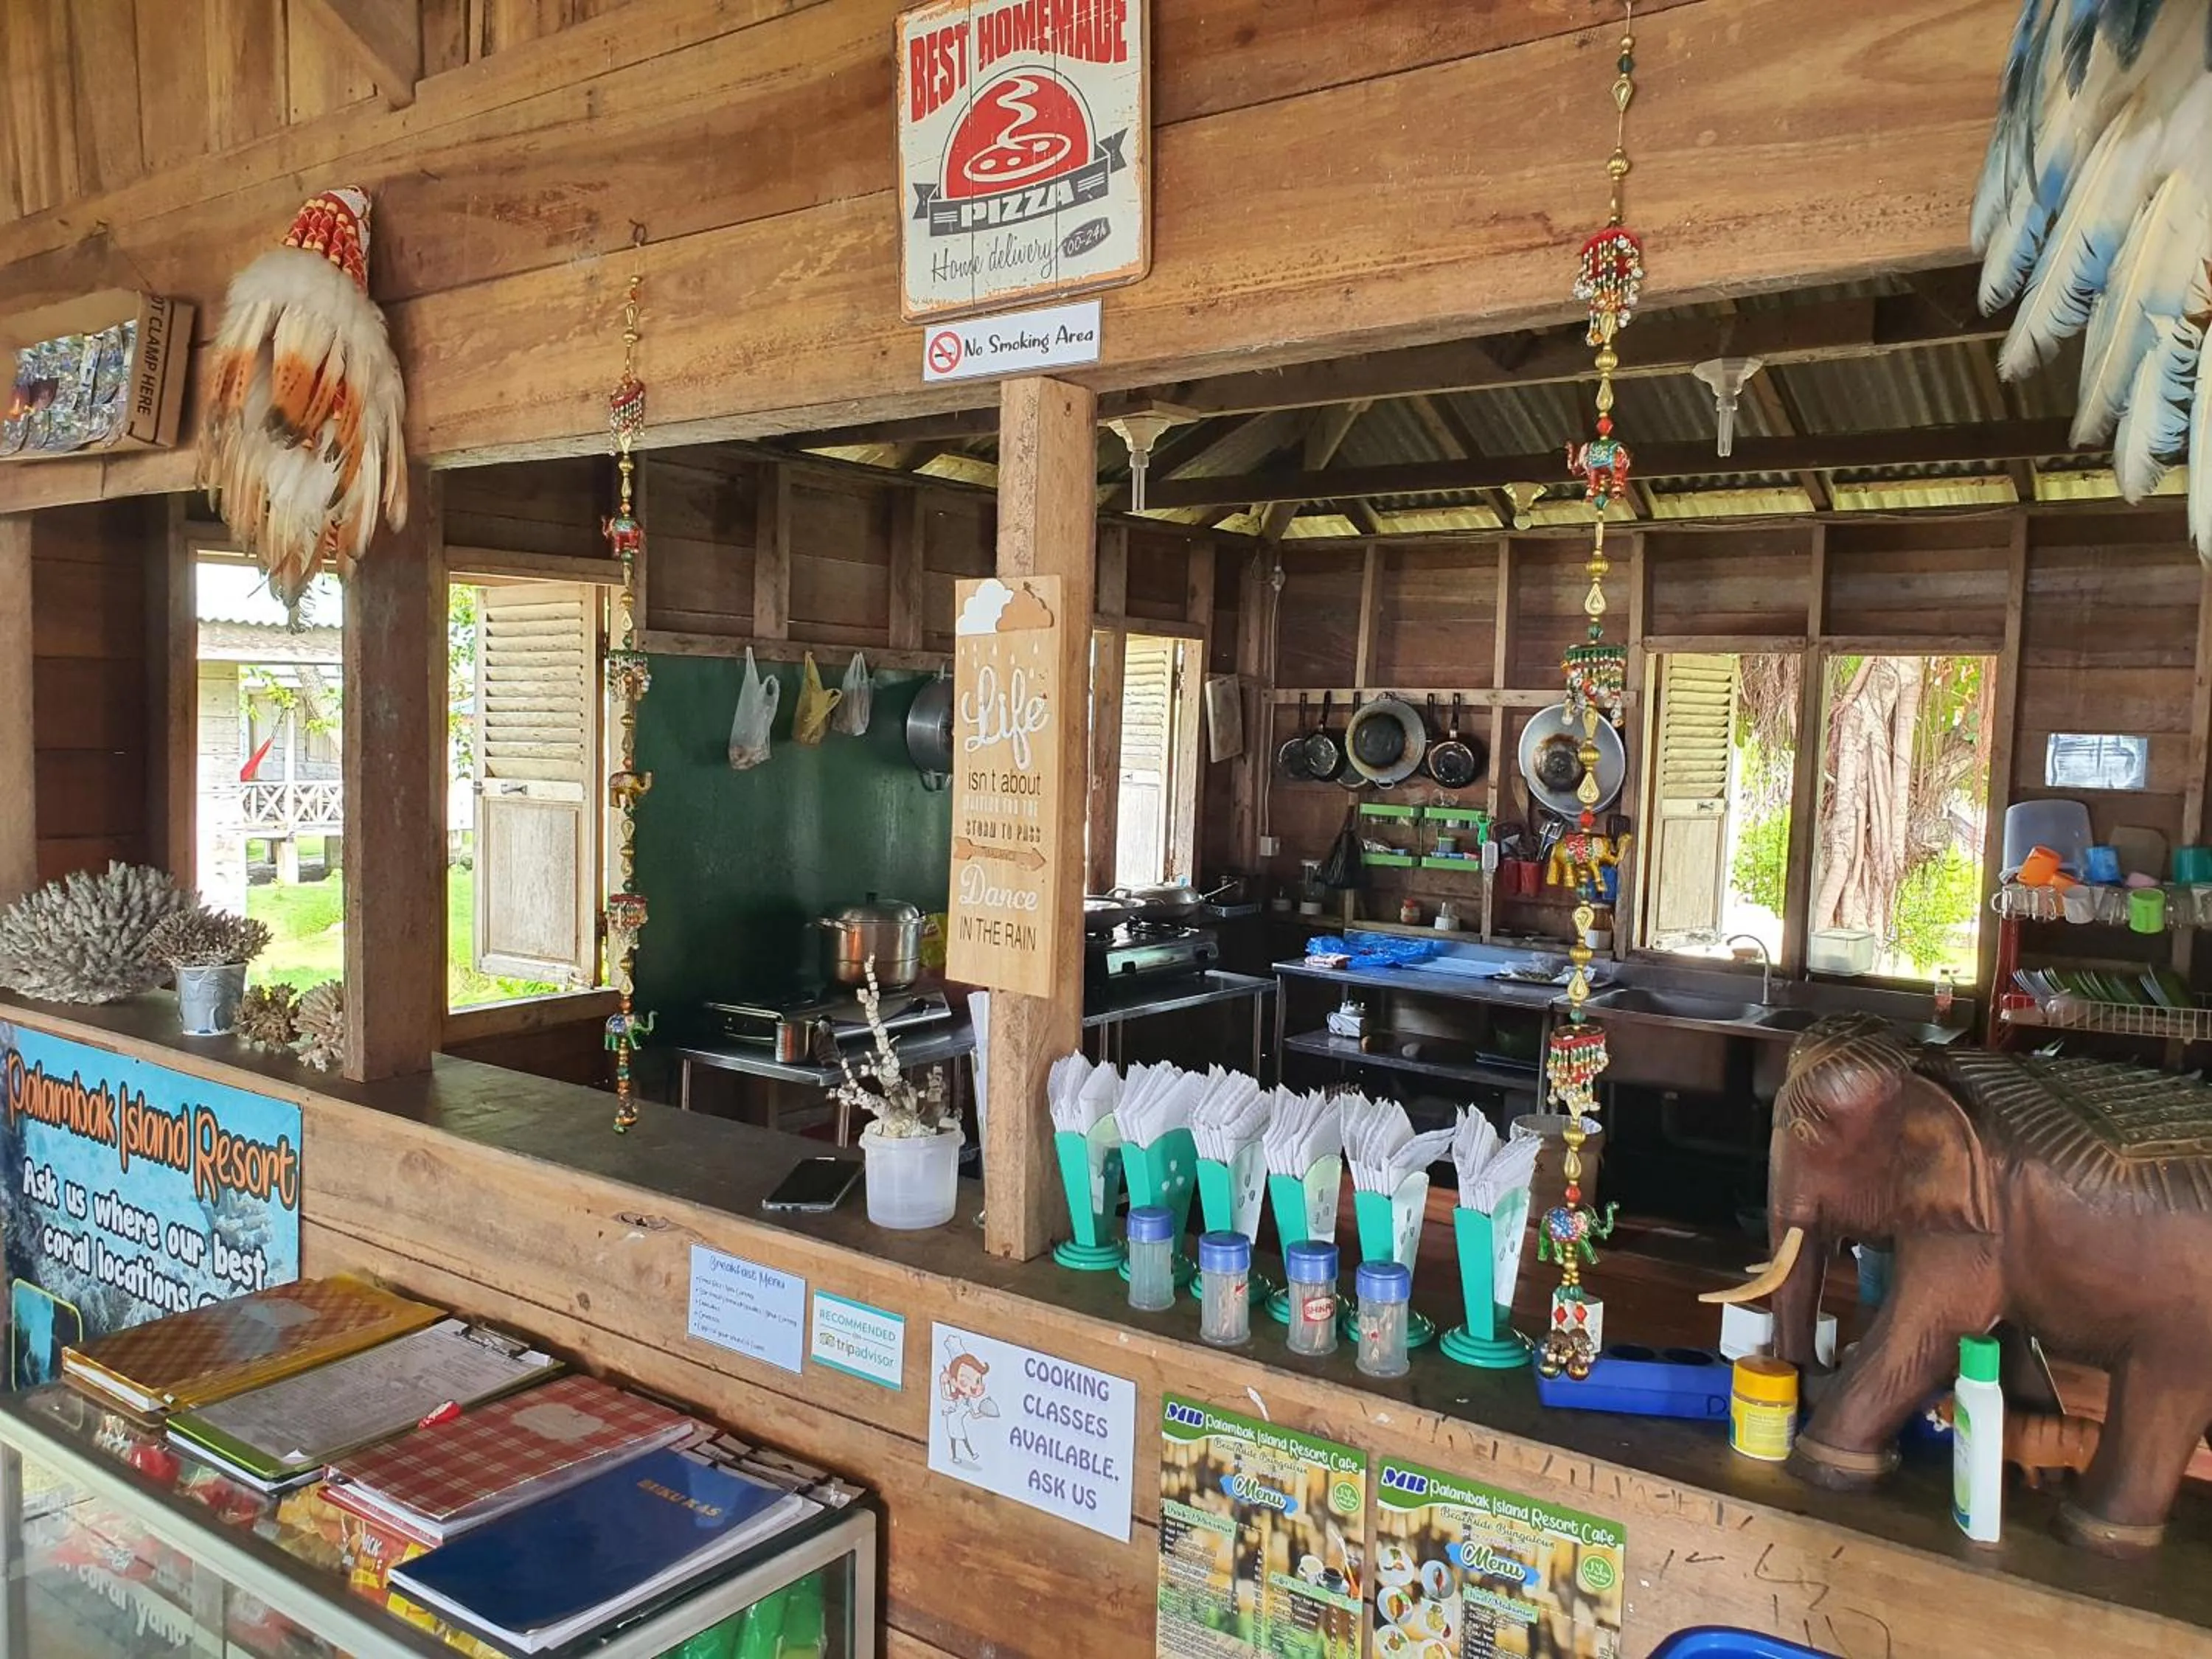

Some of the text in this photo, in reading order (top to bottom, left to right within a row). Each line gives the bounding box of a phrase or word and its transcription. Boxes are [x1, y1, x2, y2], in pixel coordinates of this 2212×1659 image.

[911, 0, 1127, 123] BEST HOMEMADE
[961, 179, 1075, 228] PIZZA
[932, 247, 984, 282] Home
[990, 232, 1060, 279] delivery
[137, 296, 165, 417] OT CLAMP HERE
[964, 324, 1094, 357] No Smoking Area
[961, 664, 1050, 771] Life
[1001, 769, 1040, 796] about
[1002, 822, 1013, 841] TO
[959, 863, 1039, 912] Dance
[959, 916, 973, 941] IN
[976, 919, 1002, 947] THE
[1005, 923, 1037, 952] RAIN
[7, 1047, 299, 1211] Palambak Island Resort
[23, 1156, 267, 1292] Ask us where our best
[44, 1225, 192, 1314] coral locations
[709, 1253, 757, 1281] Breakfast
[759, 1271, 785, 1290] Menu
[819, 1309, 896, 1342] RECOMMENDED
[836, 1338, 895, 1367] tripadvisor
[1024, 1357, 1110, 1402] COOKING
[1023, 1394, 1109, 1439] CLASSES
[1009, 1426, 1119, 1482] AVAILABLE.
[1206, 1413, 1256, 1440] Palambak
[1257, 1428, 1287, 1451] Island
[1289, 1438, 1329, 1464] Resort
[1329, 1451, 1358, 1472] Cafe
[1028, 1469, 1098, 1512] ASK US
[1233, 1475, 1286, 1510] Menu
[1429, 1478, 1490, 1509] Palambak
[1492, 1496, 1529, 1524] Island
[1531, 1508, 1580, 1535] Resort
[1581, 1523, 1616, 1547] Cafe
[1461, 1542, 1525, 1581] Menu
